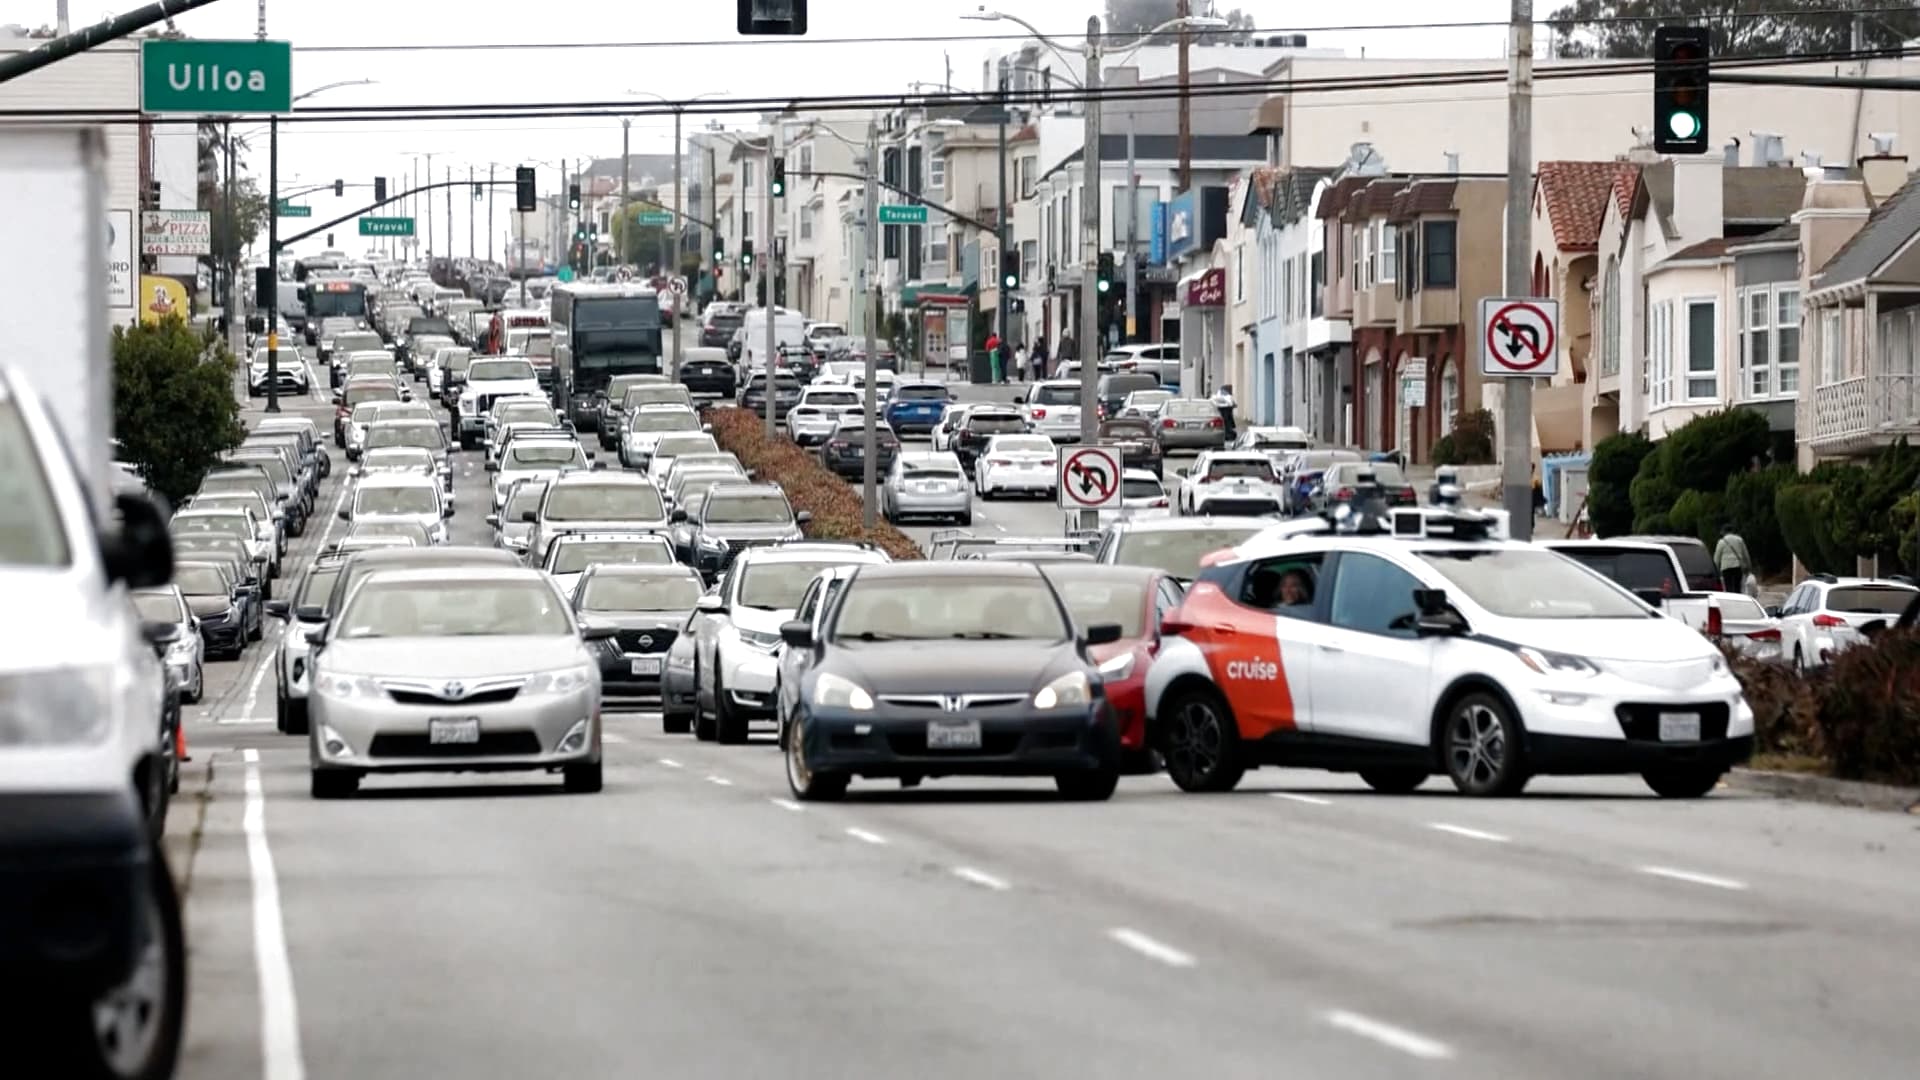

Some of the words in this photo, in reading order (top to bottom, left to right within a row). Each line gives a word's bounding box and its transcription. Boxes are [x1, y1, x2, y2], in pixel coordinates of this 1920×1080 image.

[168, 63, 266, 92] Ulloa
[886, 209, 922, 220] Taraval
[170, 222, 209, 235] PIZZA
[367, 221, 408, 232] Taraval
[1199, 288, 1222, 304] Cafe
[1227, 656, 1277, 680] cruise
